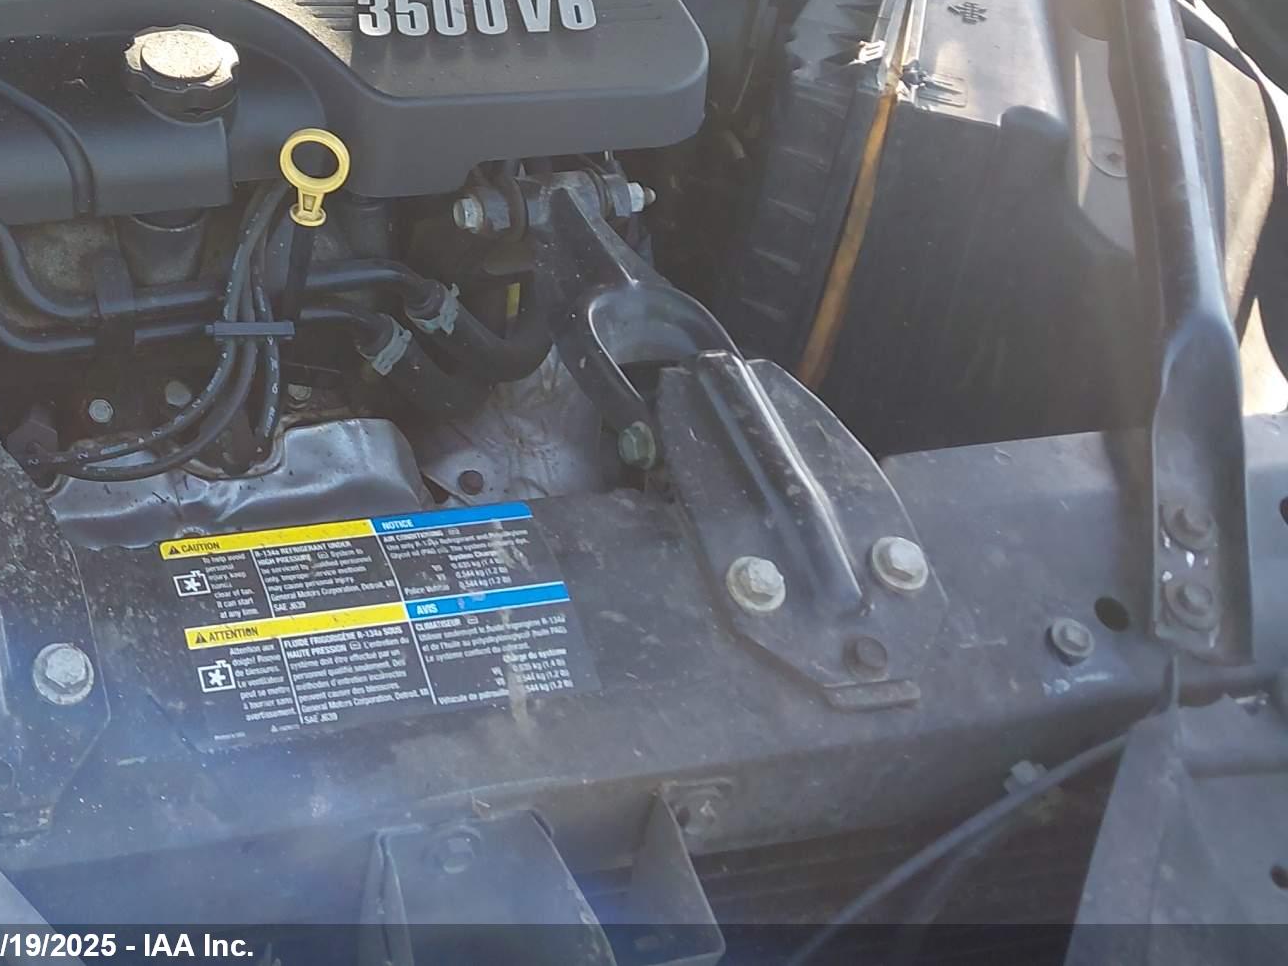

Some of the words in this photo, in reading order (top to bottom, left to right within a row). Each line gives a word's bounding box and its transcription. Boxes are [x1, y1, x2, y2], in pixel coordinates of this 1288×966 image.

[382, 519, 413, 529] NOTICE
[181, 542, 220, 553] CAUTION
[417, 603, 439, 615] AVIS
[209, 627, 259, 641] ATTENTION
